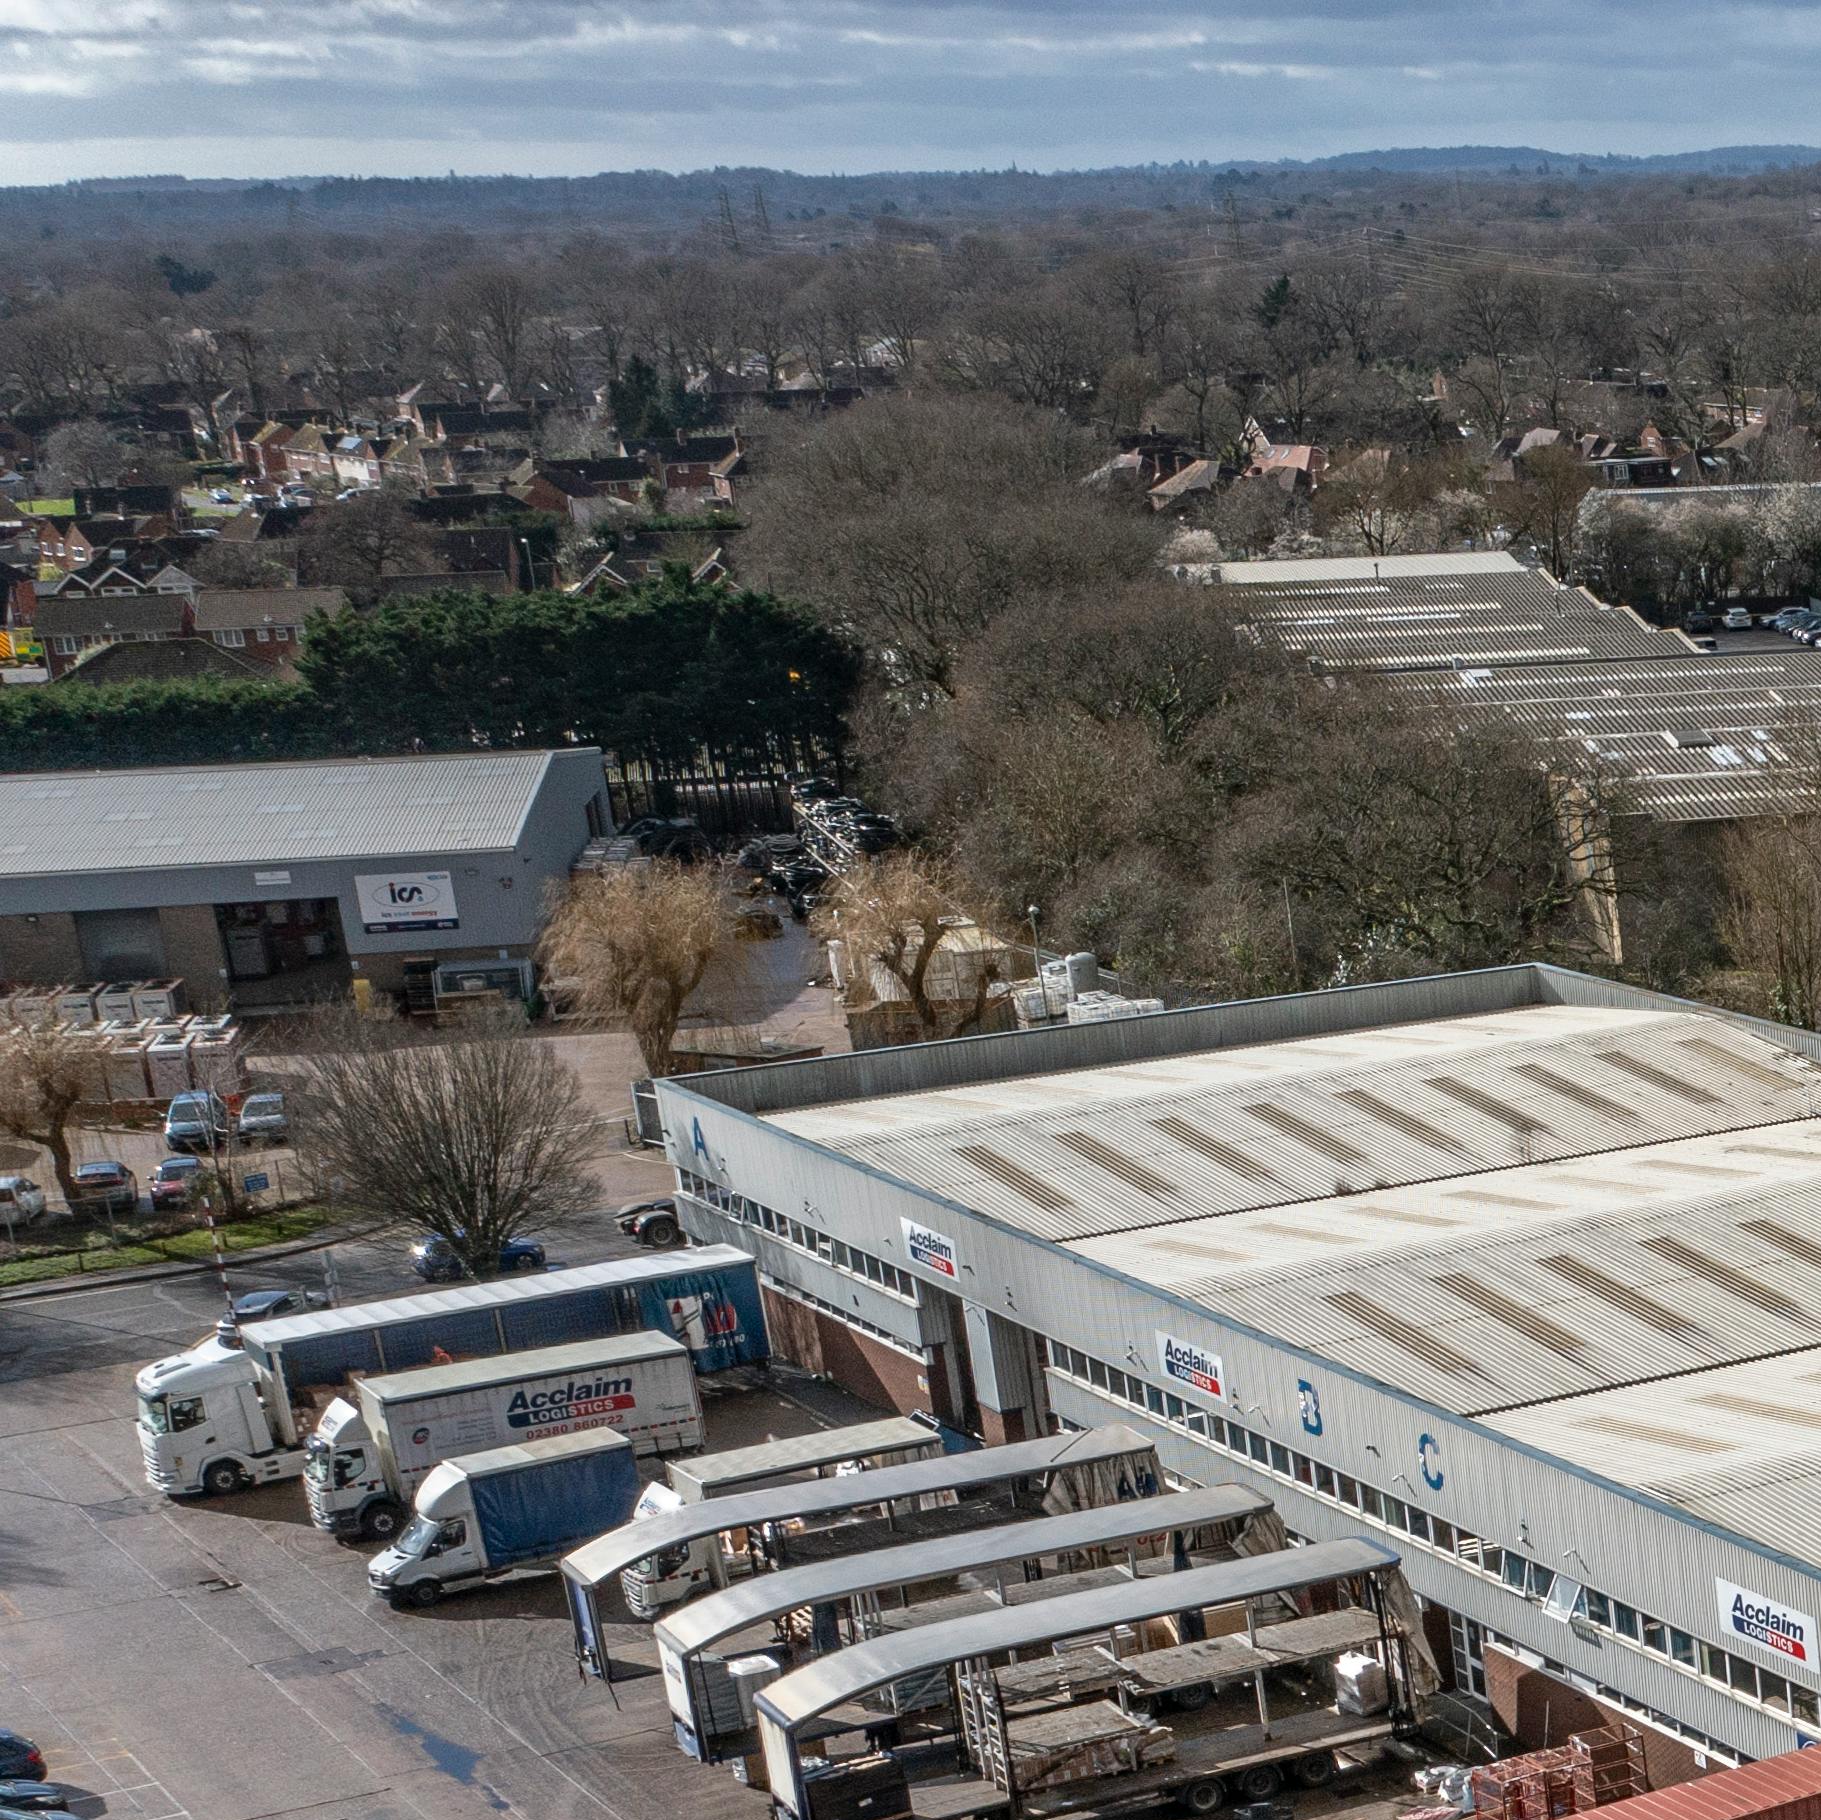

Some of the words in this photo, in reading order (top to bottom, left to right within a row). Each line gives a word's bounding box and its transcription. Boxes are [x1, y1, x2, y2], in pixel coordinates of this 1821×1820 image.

[693, 1116, 709, 1161] A
[909, 1225, 952, 1260] Acclaim
[1165, 1338, 1218, 1379] Acclaim
[507, 1376, 633, 1413] Acclaim
[529, 1400, 615, 1424] LOGISTICS
[526, 1424, 569, 1440] 02380
[573, 1414, 625, 1431] 860722
[1418, 1432, 1444, 1491] C
[1731, 1593, 1805, 1642] Acclaim
[1743, 1621, 1794, 1653] LOGISTICS
